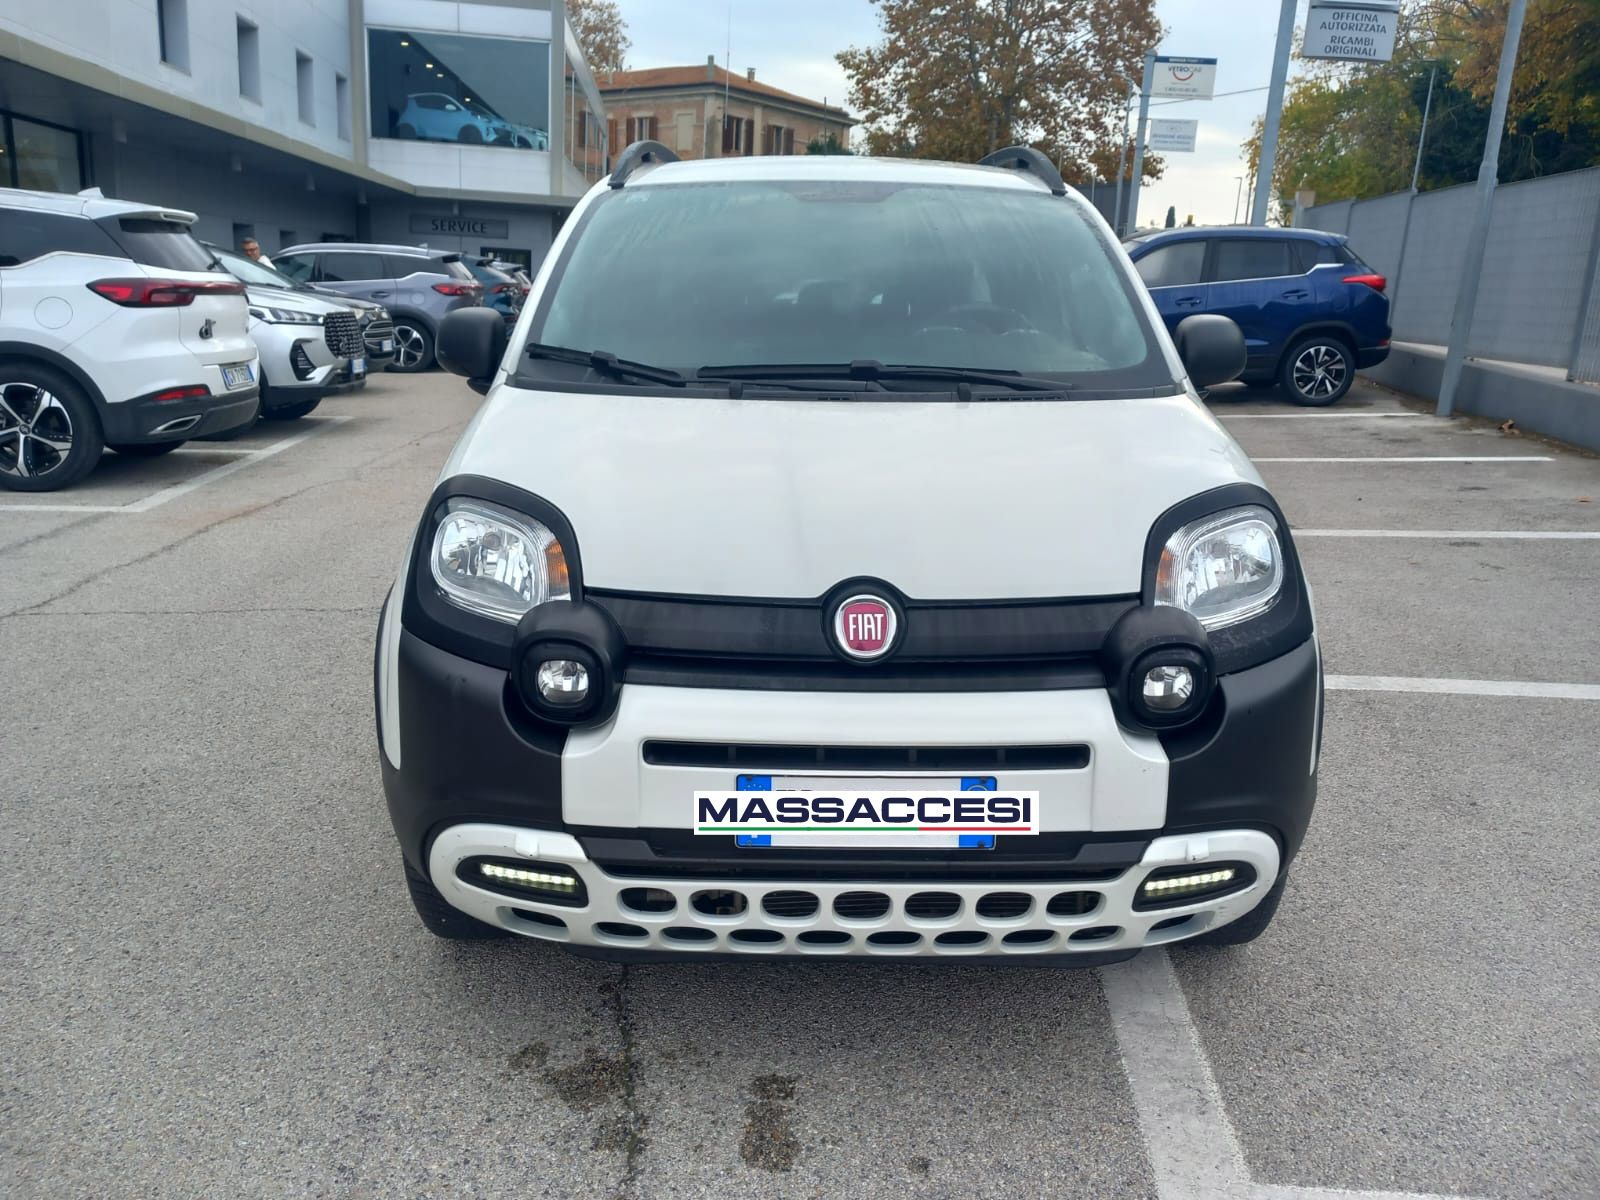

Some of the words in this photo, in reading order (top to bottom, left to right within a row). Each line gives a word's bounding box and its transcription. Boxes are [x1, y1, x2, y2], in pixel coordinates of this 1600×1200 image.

[1332, 11, 1378, 22] OFFICINA
[1320, 21, 1386, 34] AUTORIZZATA
[1330, 35, 1374, 46] RICAMBI
[1324, 45, 1376, 56] ORIGINALI
[431, 219, 488, 233] SERVICE
[848, 613, 885, 641] FIAT
